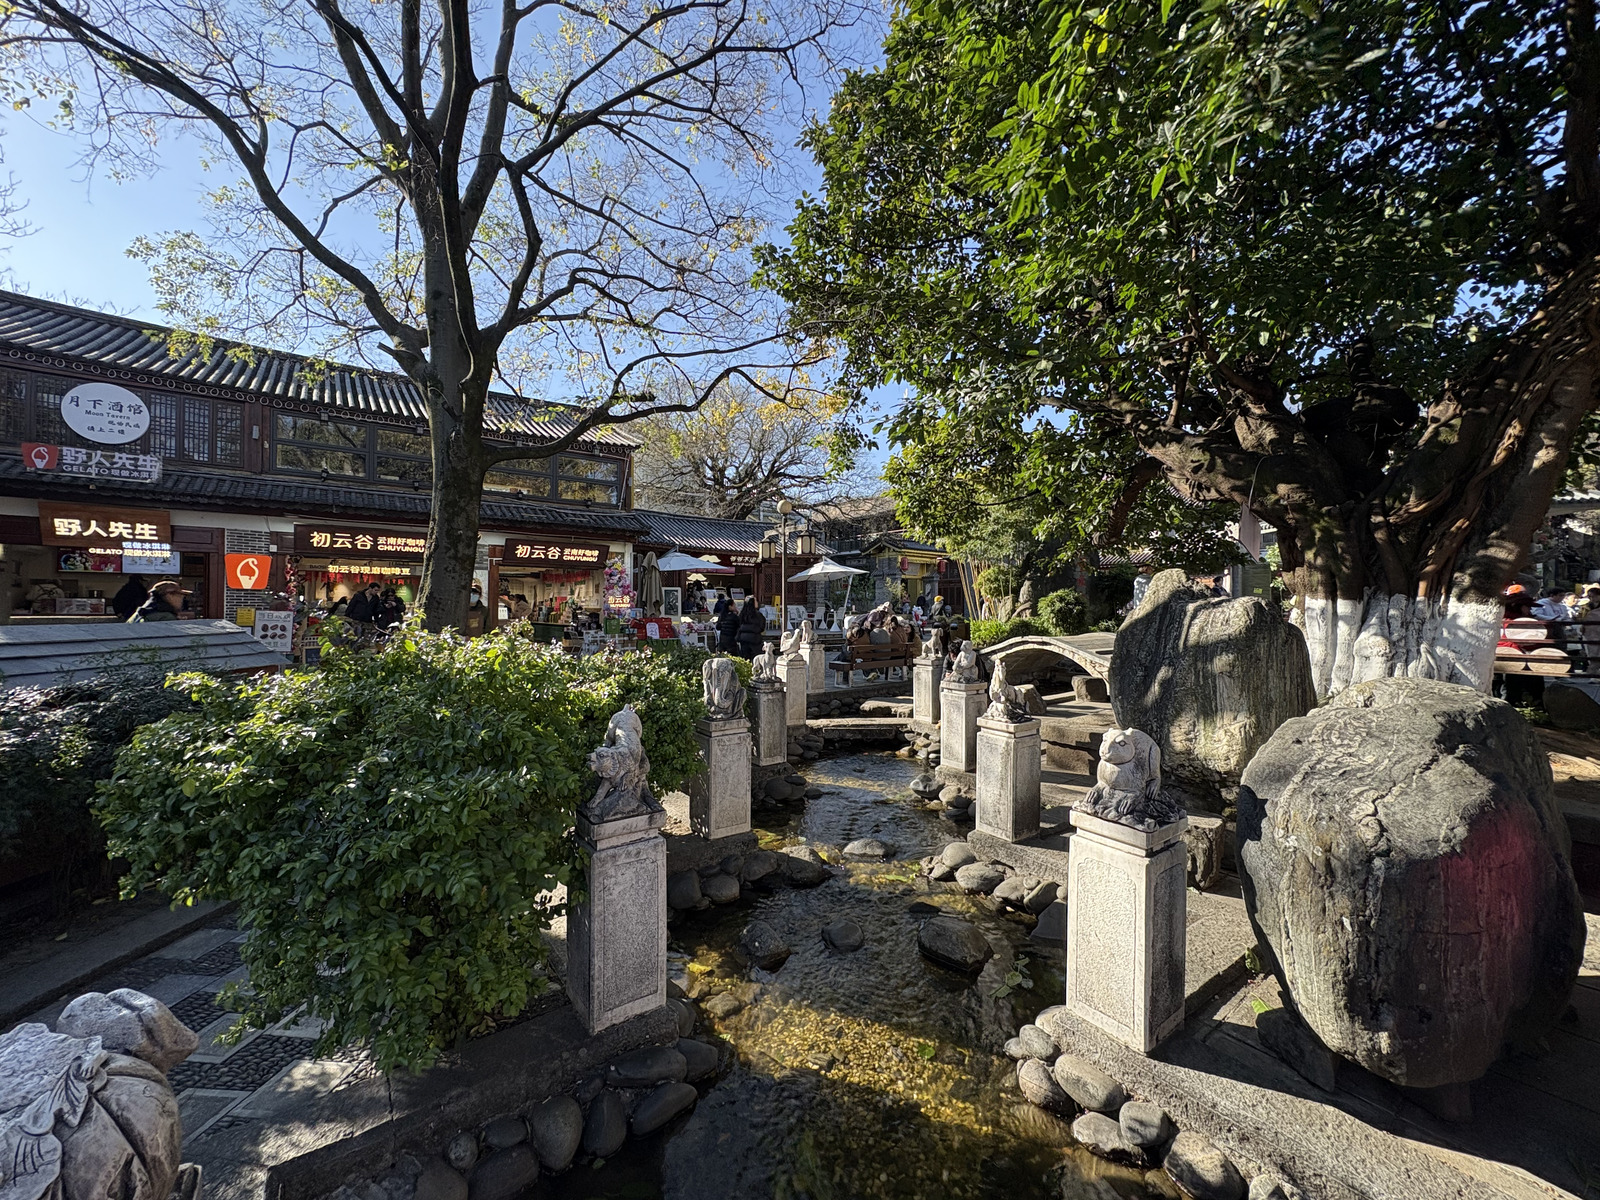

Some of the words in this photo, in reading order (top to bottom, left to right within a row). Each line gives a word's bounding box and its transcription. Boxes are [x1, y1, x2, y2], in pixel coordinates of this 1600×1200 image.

[68, 395, 144, 416] 月下酒馆
[85, 409, 105, 417] Moon
[106, 411, 131, 420] Tavern
[62, 446, 160, 471] 野人先生
[62, 464, 109, 475] GELATO
[53, 517, 159, 541] 野人先生
[309, 531, 374, 550] 初云谷
[377, 536, 426, 547] 云南好咖啡
[88, 547, 123, 555] GELATO
[377, 544, 425, 553] CHUYUNGU
[515, 544, 562, 560] 初云谷
[327, 564, 411, 576] 初云谷现磨咖啡豆
